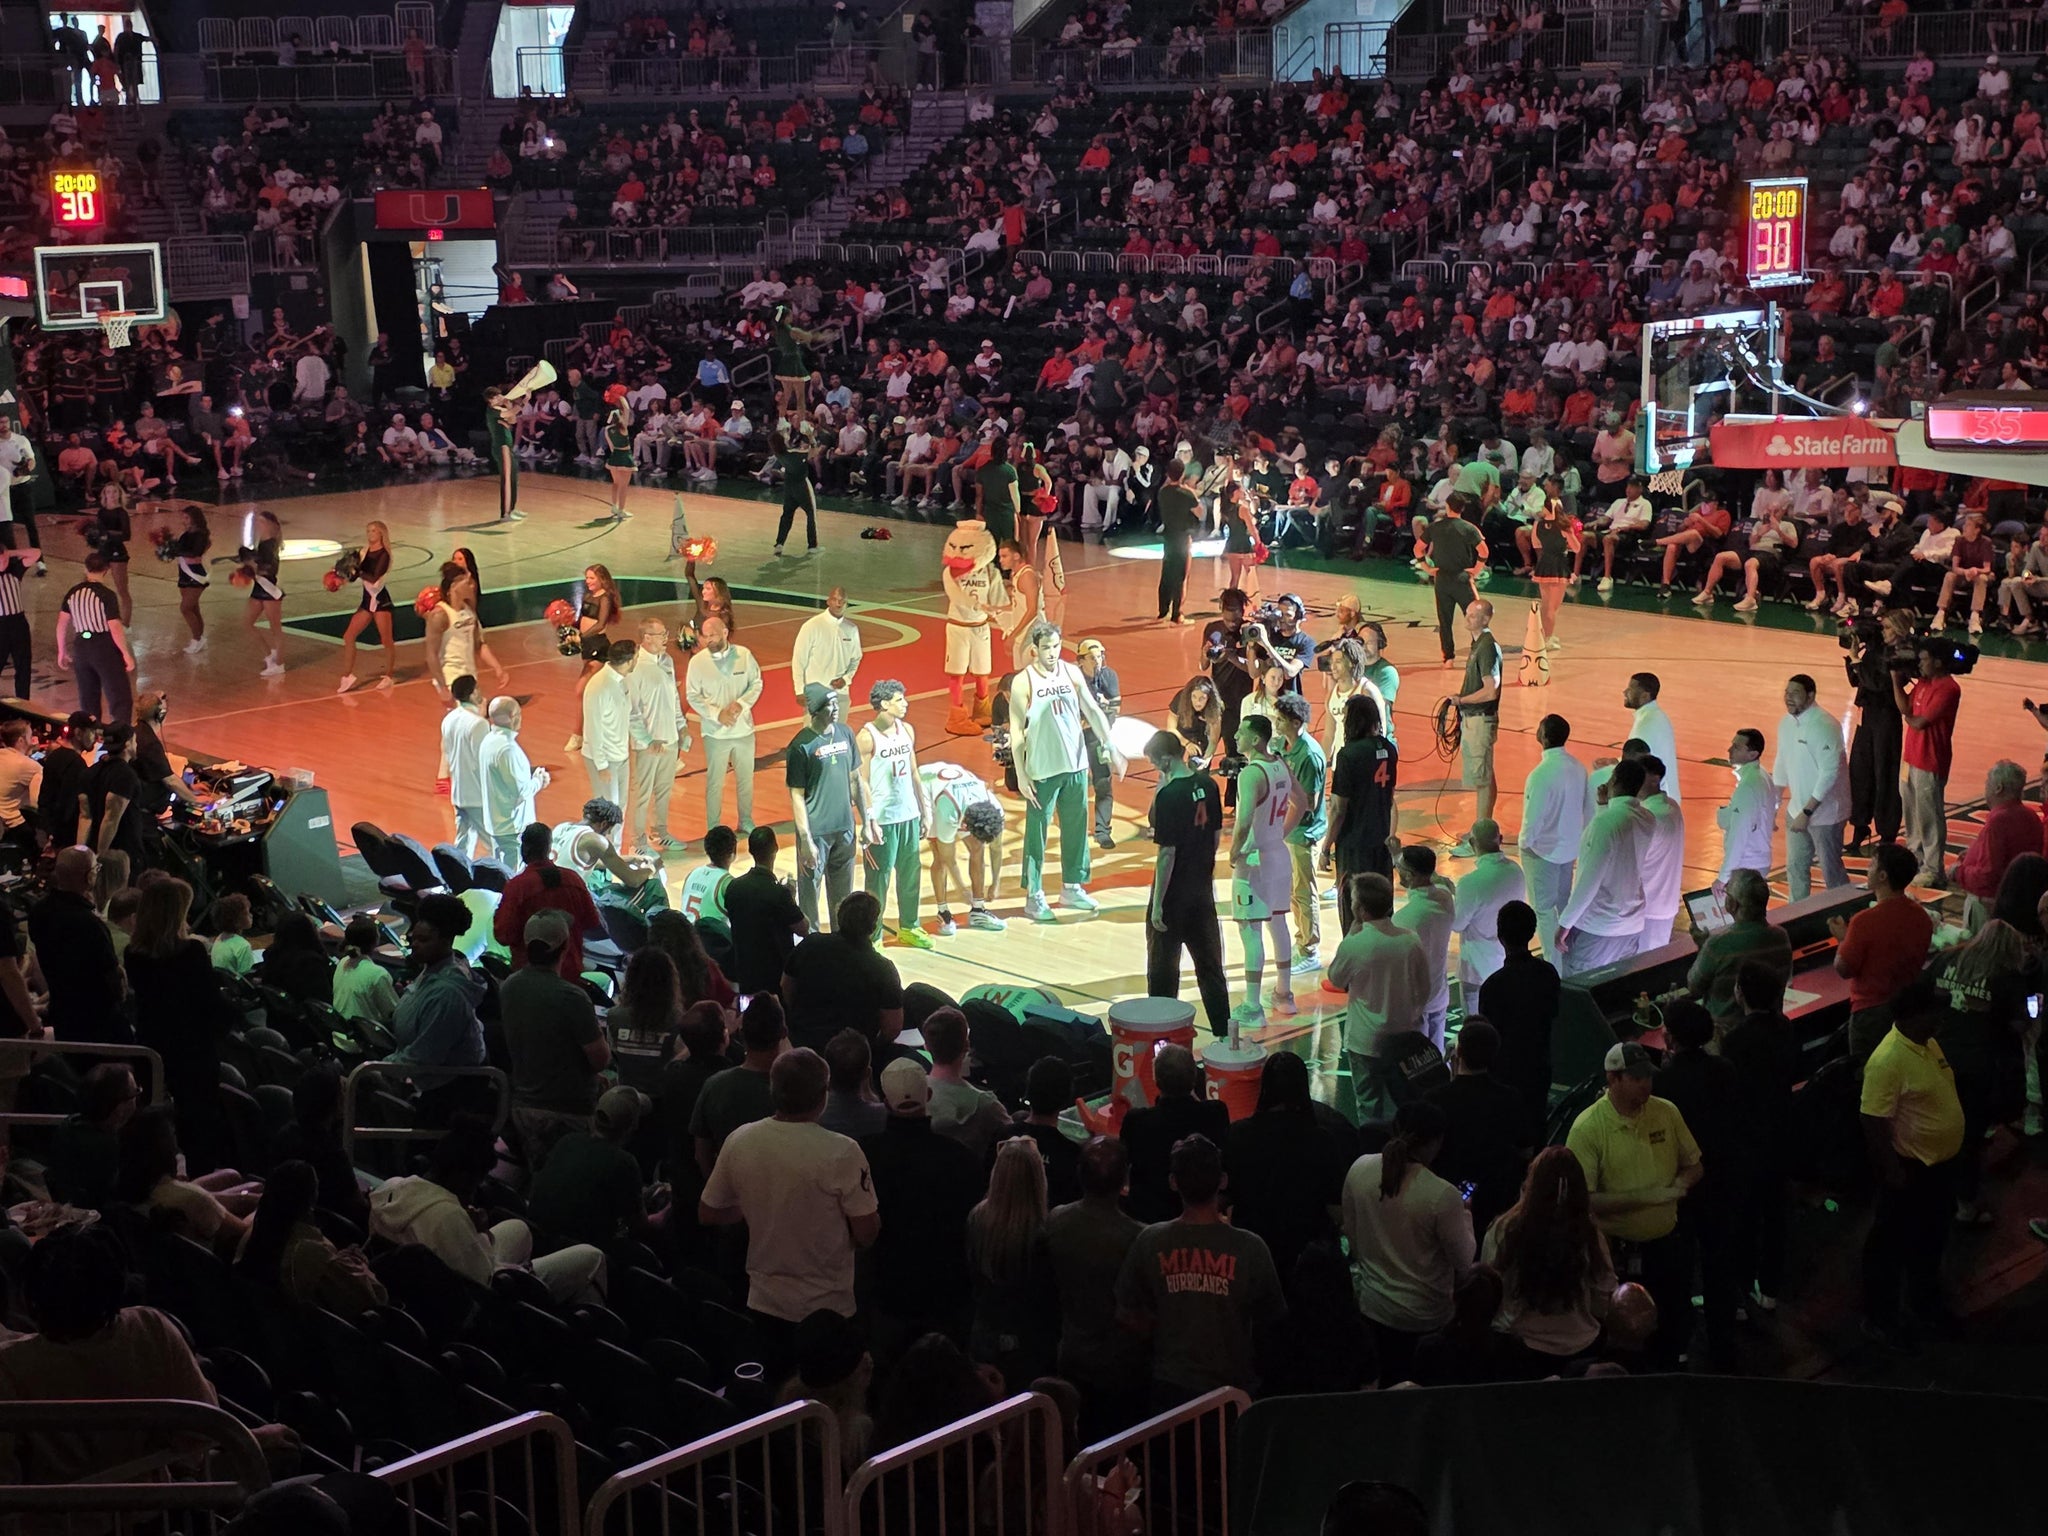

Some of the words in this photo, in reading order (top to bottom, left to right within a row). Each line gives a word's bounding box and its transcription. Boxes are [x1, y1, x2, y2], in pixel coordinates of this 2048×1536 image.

[55, 174, 96, 193] 20:00
[61, 191, 95, 221] 30
[1752, 190, 1797, 219] 20:00
[1756, 221, 1791, 271] 30
[1036, 684, 1072, 698] CANES
[880, 743, 911, 758] CANES
[892, 759, 907, 777] 12
[1373, 760, 1391, 789] 4
[1268, 793, 1289, 826] 14
[686, 895, 702, 921] 5
[1113, 1042, 1135, 1078] G
[1205, 1080, 1219, 1100] G
[1157, 1247, 1238, 1281] MIAMI
[1165, 1271, 1230, 1297] HURRICANES
